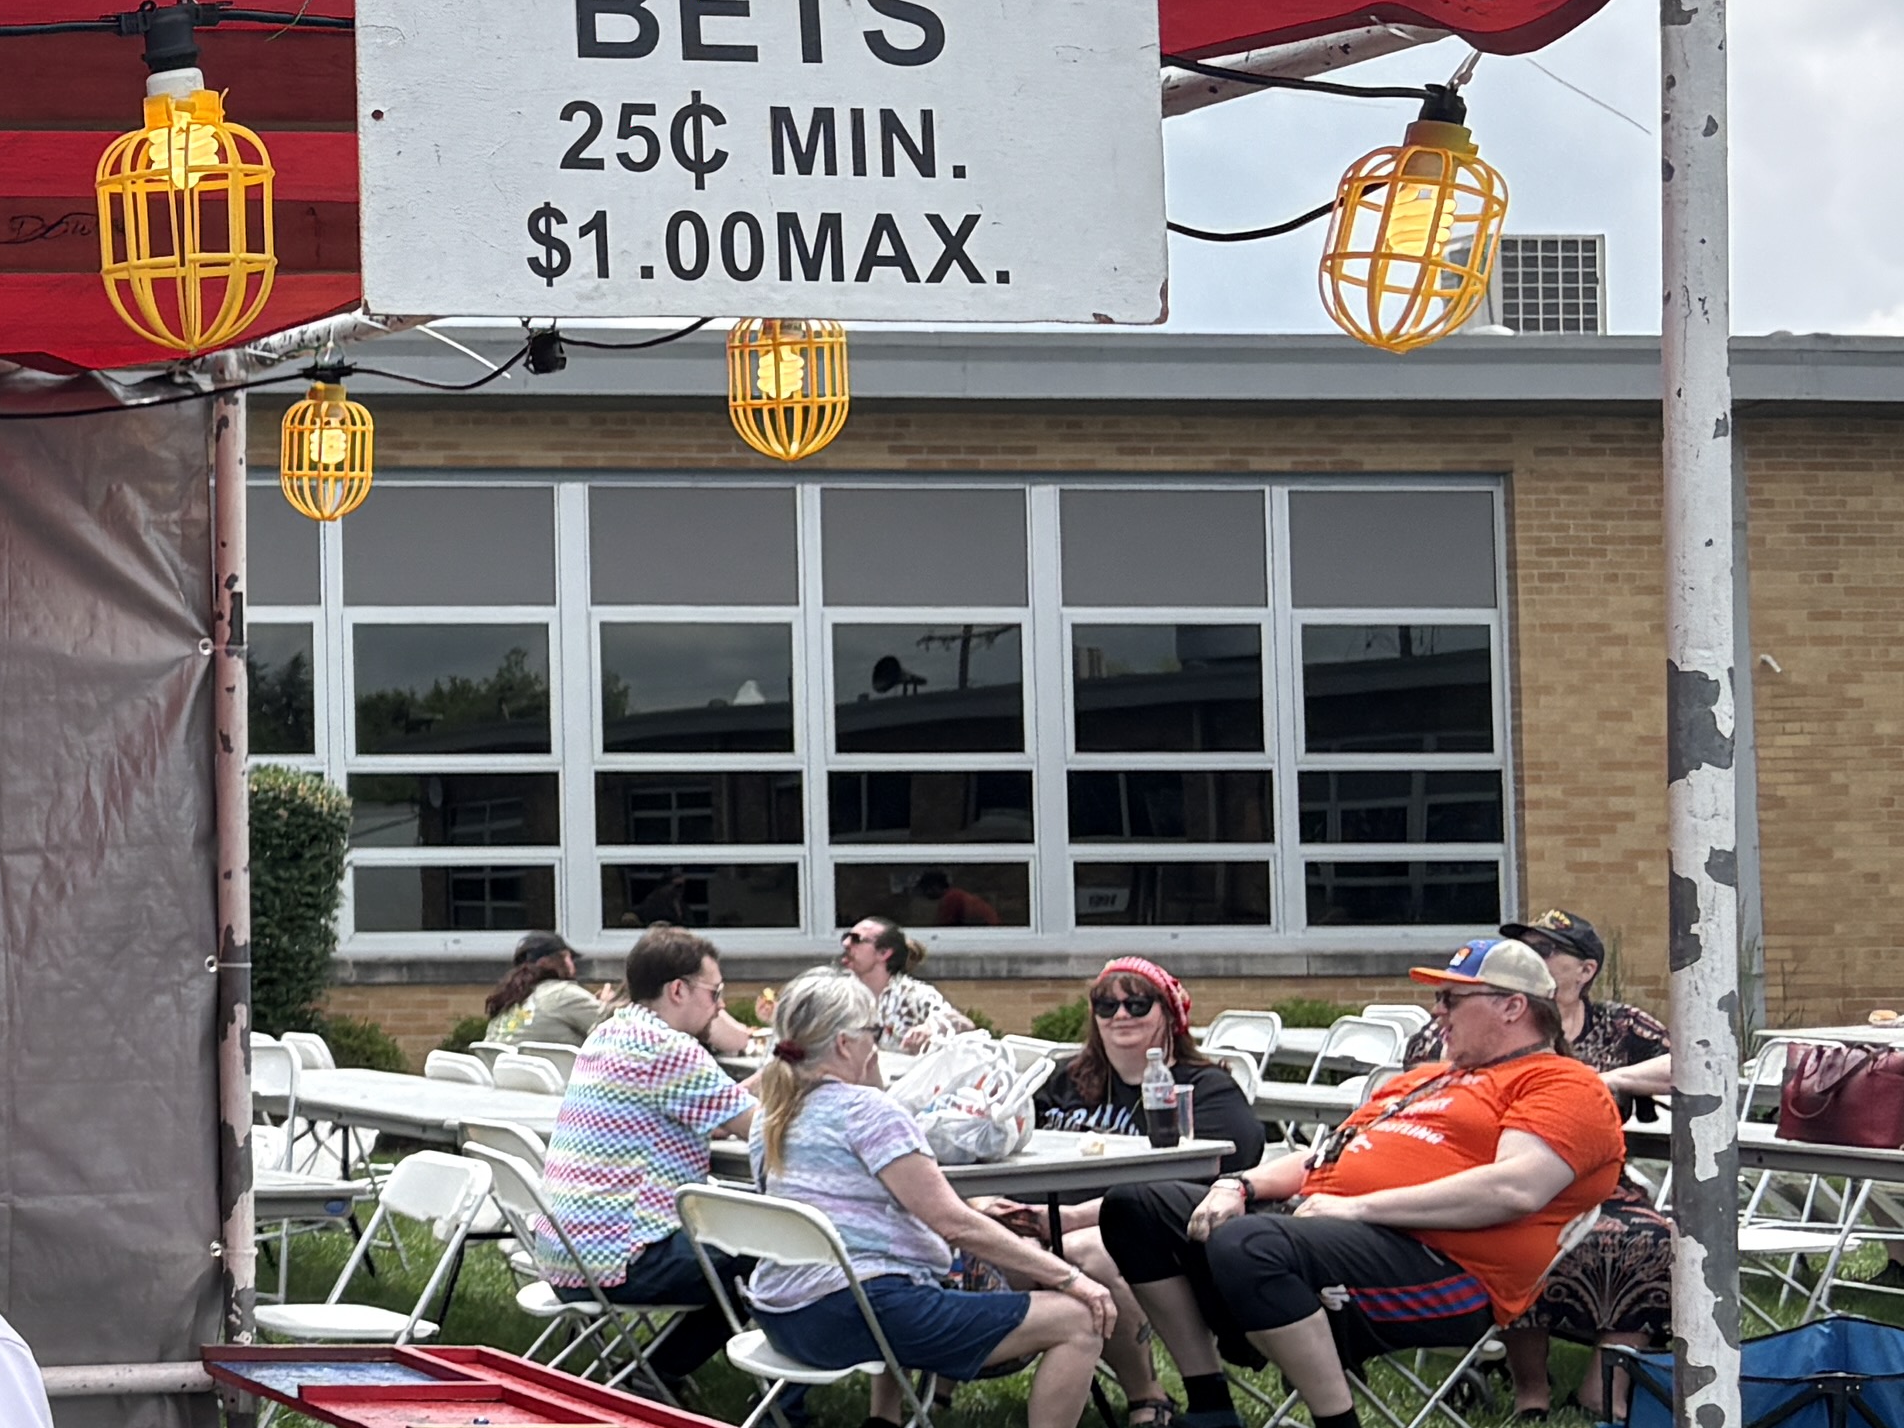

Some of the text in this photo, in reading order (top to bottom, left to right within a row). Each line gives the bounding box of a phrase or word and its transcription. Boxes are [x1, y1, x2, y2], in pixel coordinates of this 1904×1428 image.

[558, 90, 968, 191] 25¢ MIN.
[10, 215, 126, 241] DOW
